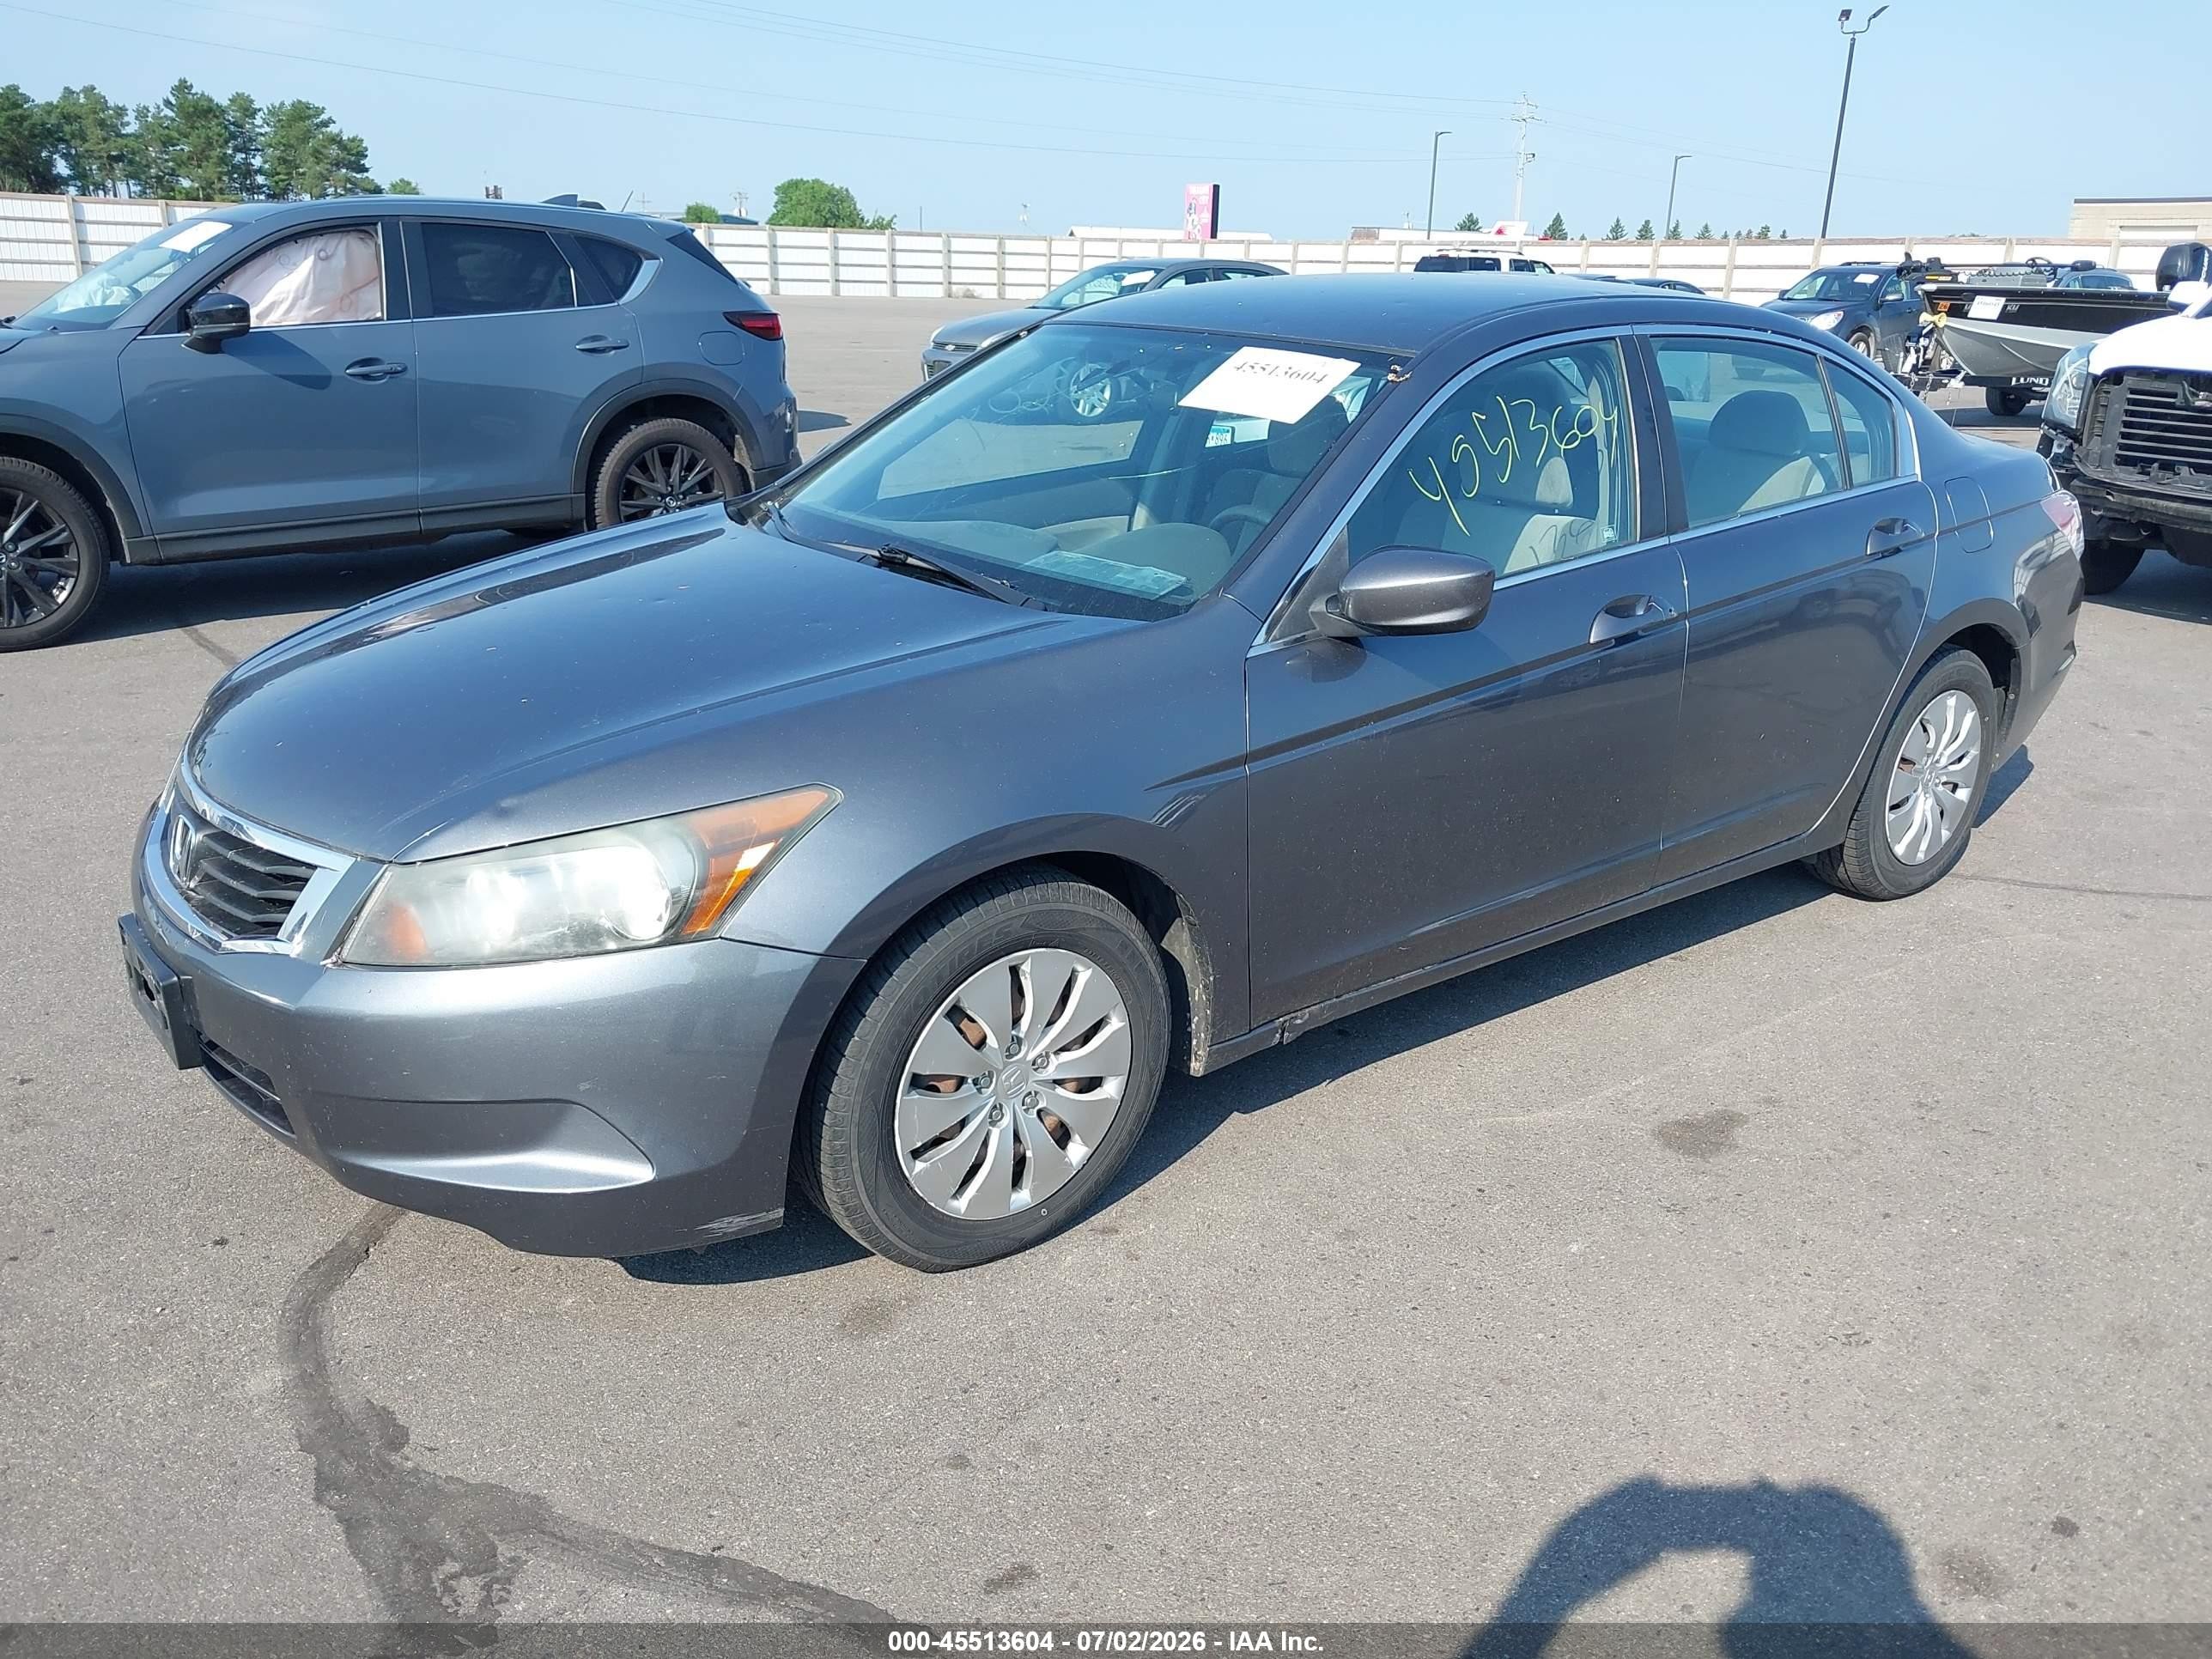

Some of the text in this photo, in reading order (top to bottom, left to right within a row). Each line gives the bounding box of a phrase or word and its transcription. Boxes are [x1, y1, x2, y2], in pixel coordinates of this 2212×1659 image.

[1234, 361, 1329, 384] 45513604
[2011, 377, 2049, 386] LUND
[1408, 395, 1619, 537] 45513604
